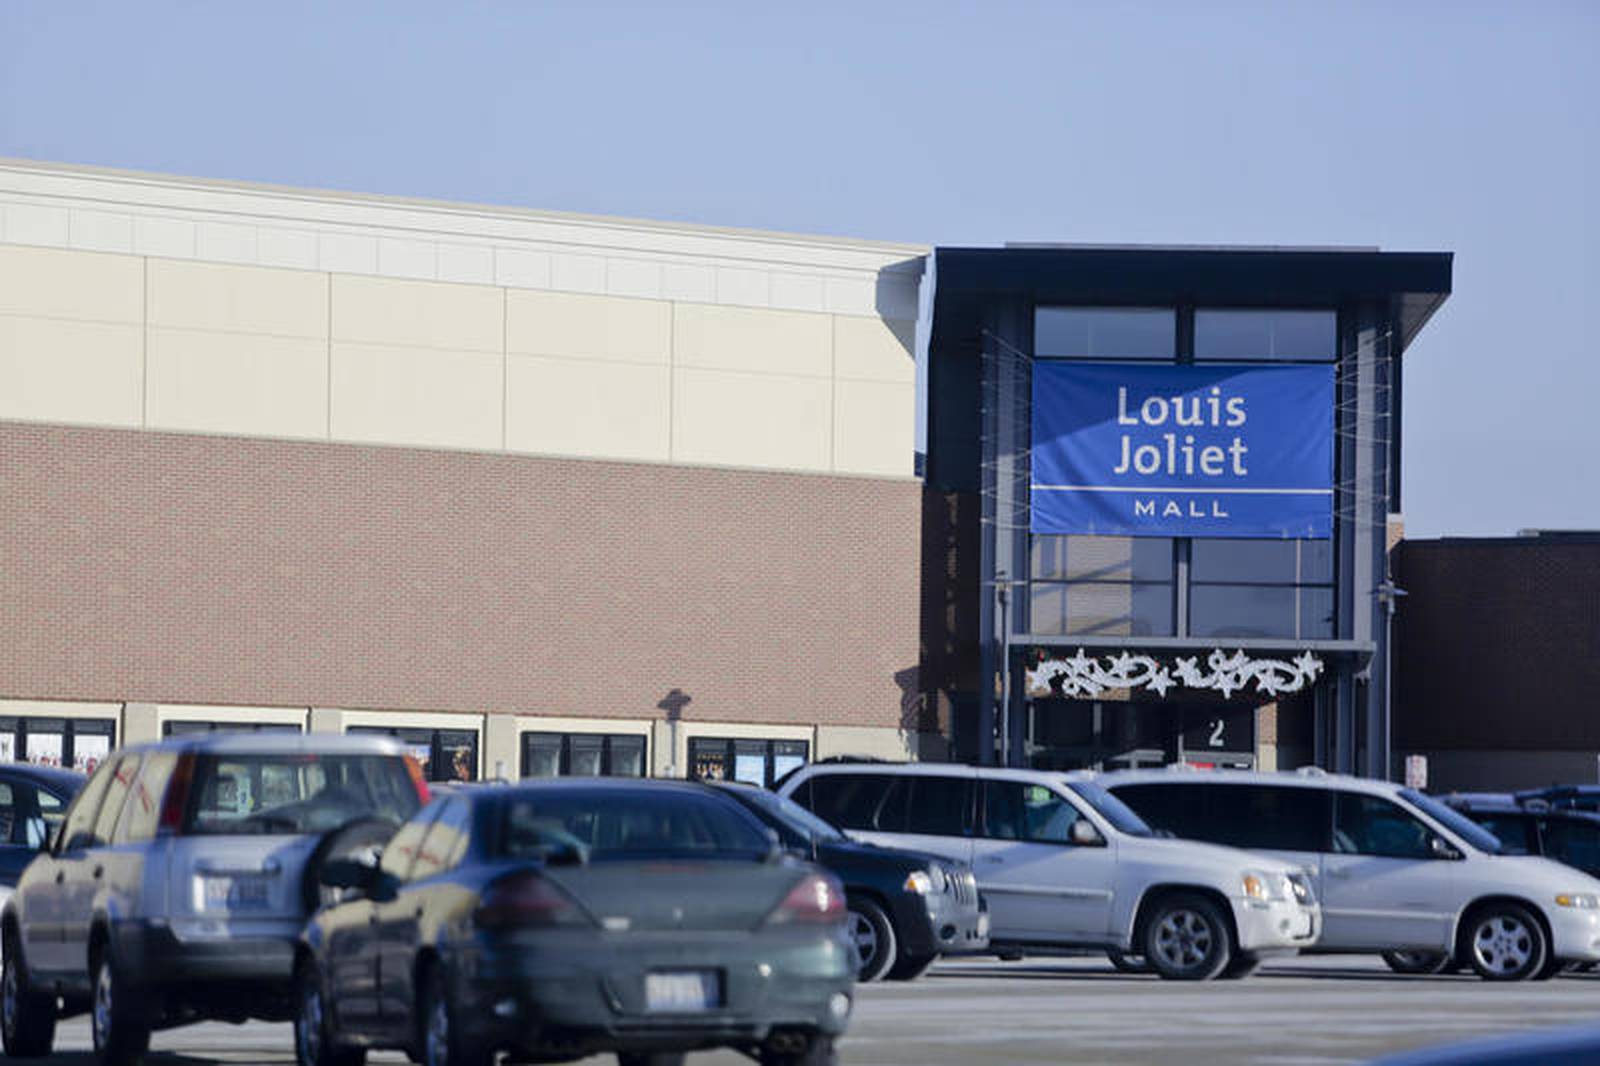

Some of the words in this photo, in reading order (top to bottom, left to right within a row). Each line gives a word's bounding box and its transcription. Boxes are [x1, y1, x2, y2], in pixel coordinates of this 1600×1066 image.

[1118, 387, 1247, 427] Louis
[1114, 434, 1248, 475] Joliet
[1134, 500, 1229, 518] MALL
[1209, 719, 1224, 747] 2
